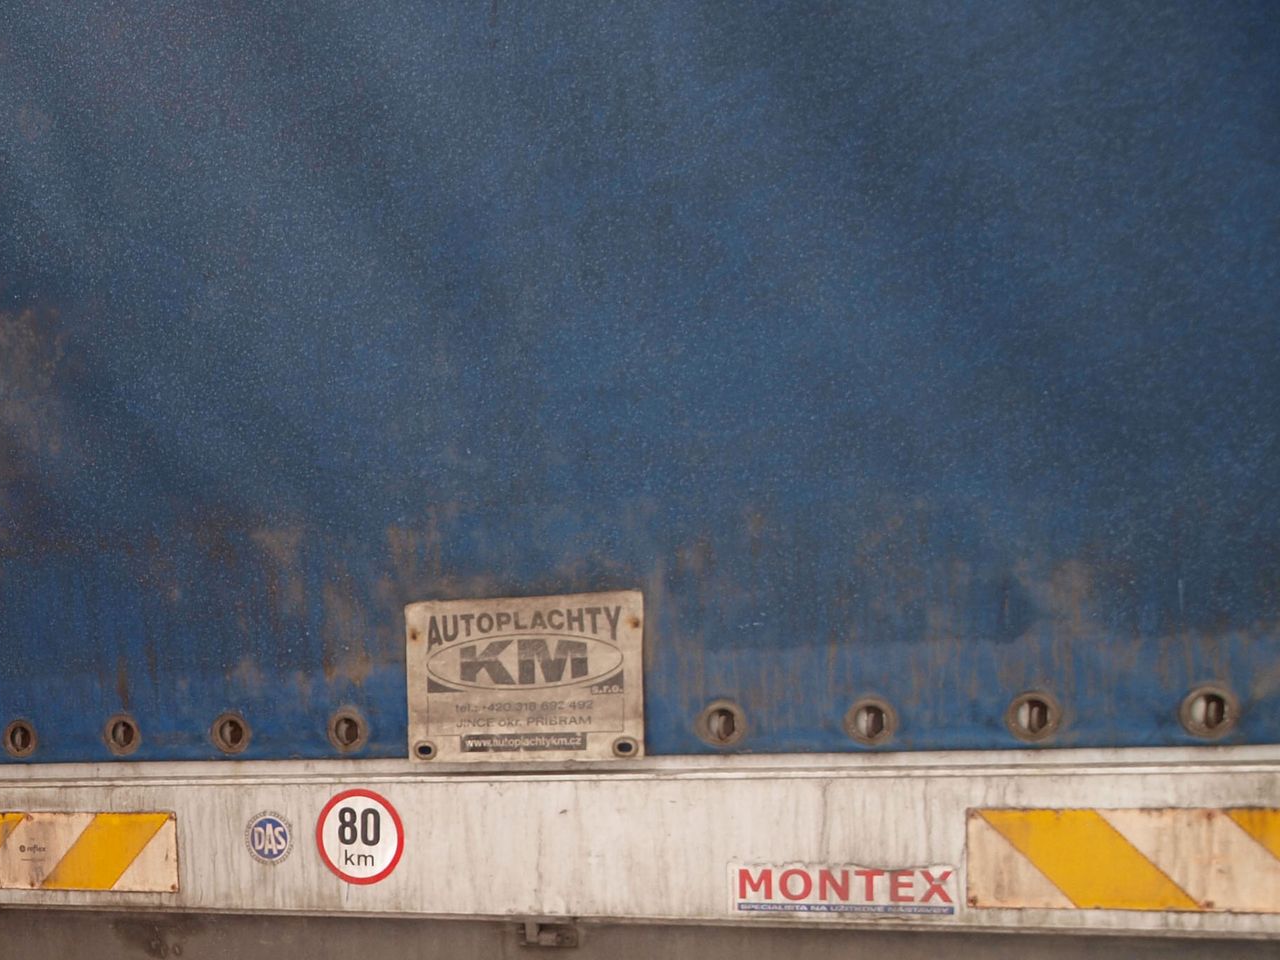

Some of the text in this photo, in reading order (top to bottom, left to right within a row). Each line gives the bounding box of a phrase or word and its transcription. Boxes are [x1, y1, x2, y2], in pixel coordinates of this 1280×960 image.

[426, 606, 622, 654] AUTOPLACHTY
[459, 638, 589, 686] KM
[253, 823, 286, 855] DAS
[337, 806, 382, 847] 80
[344, 849, 375, 867] km
[738, 868, 953, 904] MONTEX
